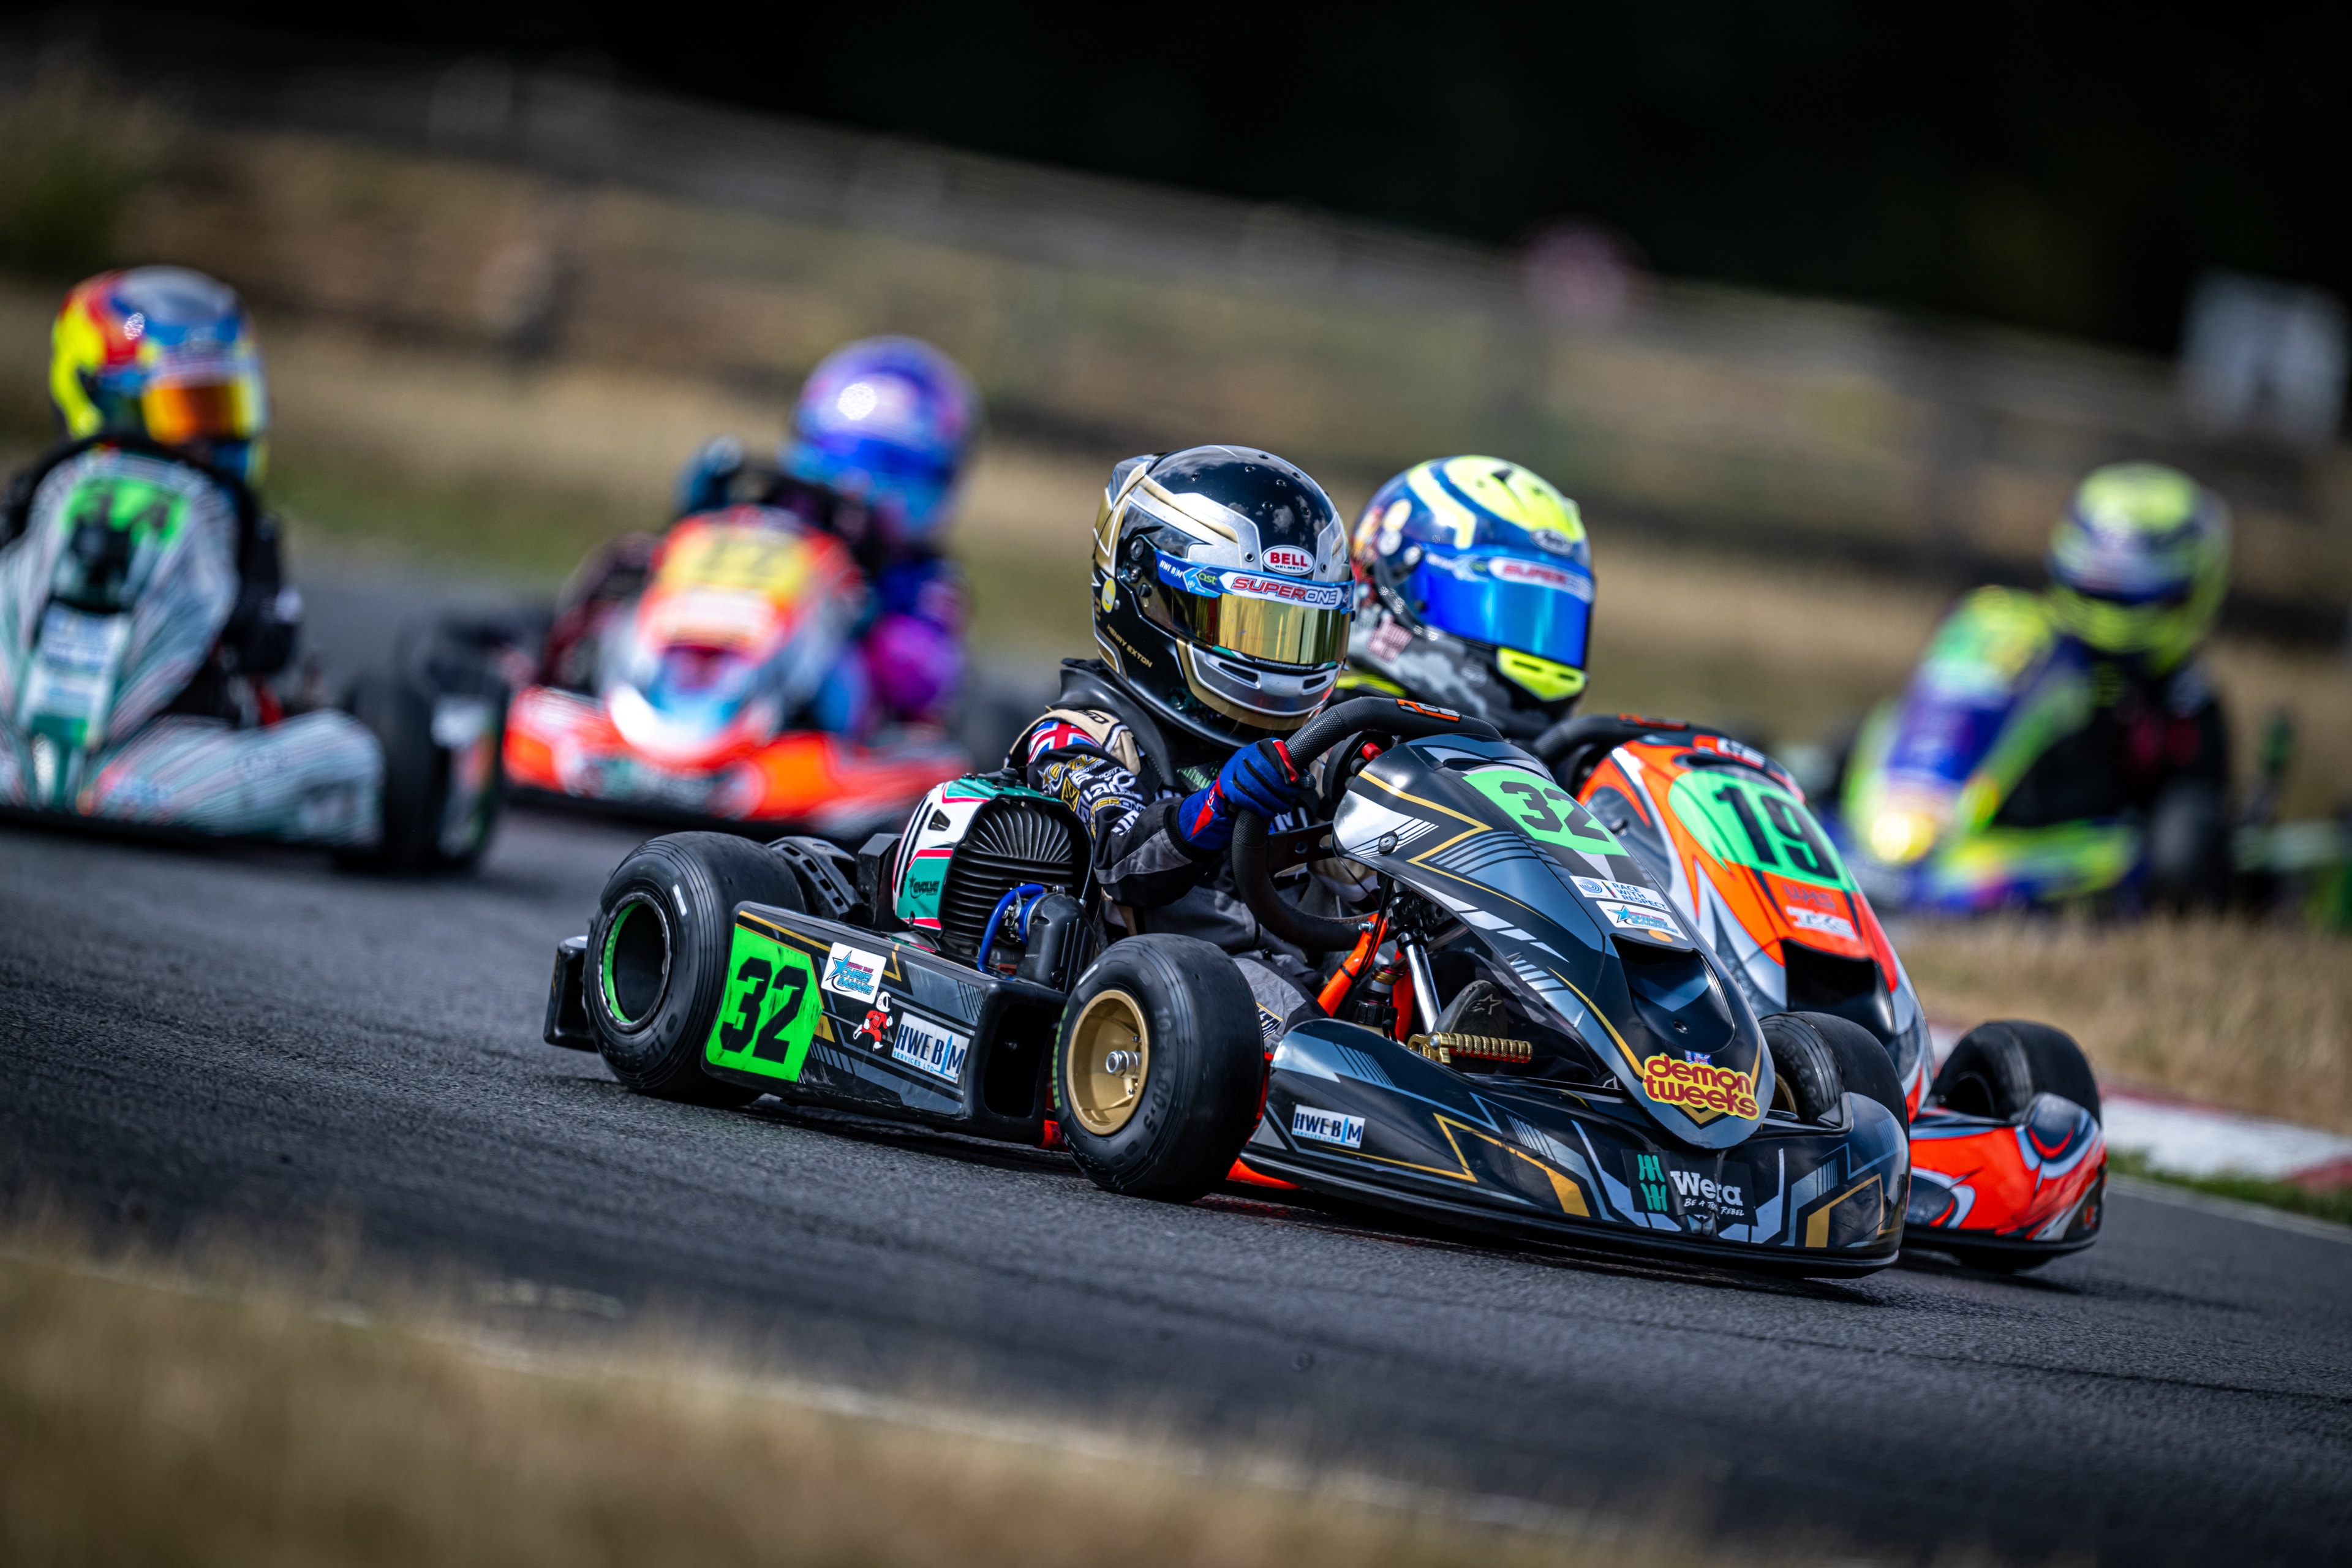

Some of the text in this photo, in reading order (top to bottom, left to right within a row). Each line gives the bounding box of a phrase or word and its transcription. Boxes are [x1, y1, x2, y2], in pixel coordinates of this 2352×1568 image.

[1270, 552, 1308, 568] BELL
[1107, 624, 1153, 668] HENRY EXTON
[1499, 781, 1610, 842] 32
[1714, 785, 1839, 880] 19
[1611, 883, 1640, 893] RACE
[1616, 889, 1648, 899] WITH
[1621, 895, 1667, 910] RESPECT
[839, 967, 873, 984] CHRIS
[719, 956, 809, 1065] 32
[893, 1050, 935, 1072] SERVICES LTD
[1647, 1055, 1752, 1096] demon
[1643, 1075, 1758, 1117] tweeks
[1293, 1130, 1321, 1140] SERVICES
[1670, 1170, 1744, 1207] Wera
[1684, 1198, 1697, 1207] BE
[1721, 1206, 1745, 1216] REBEL
